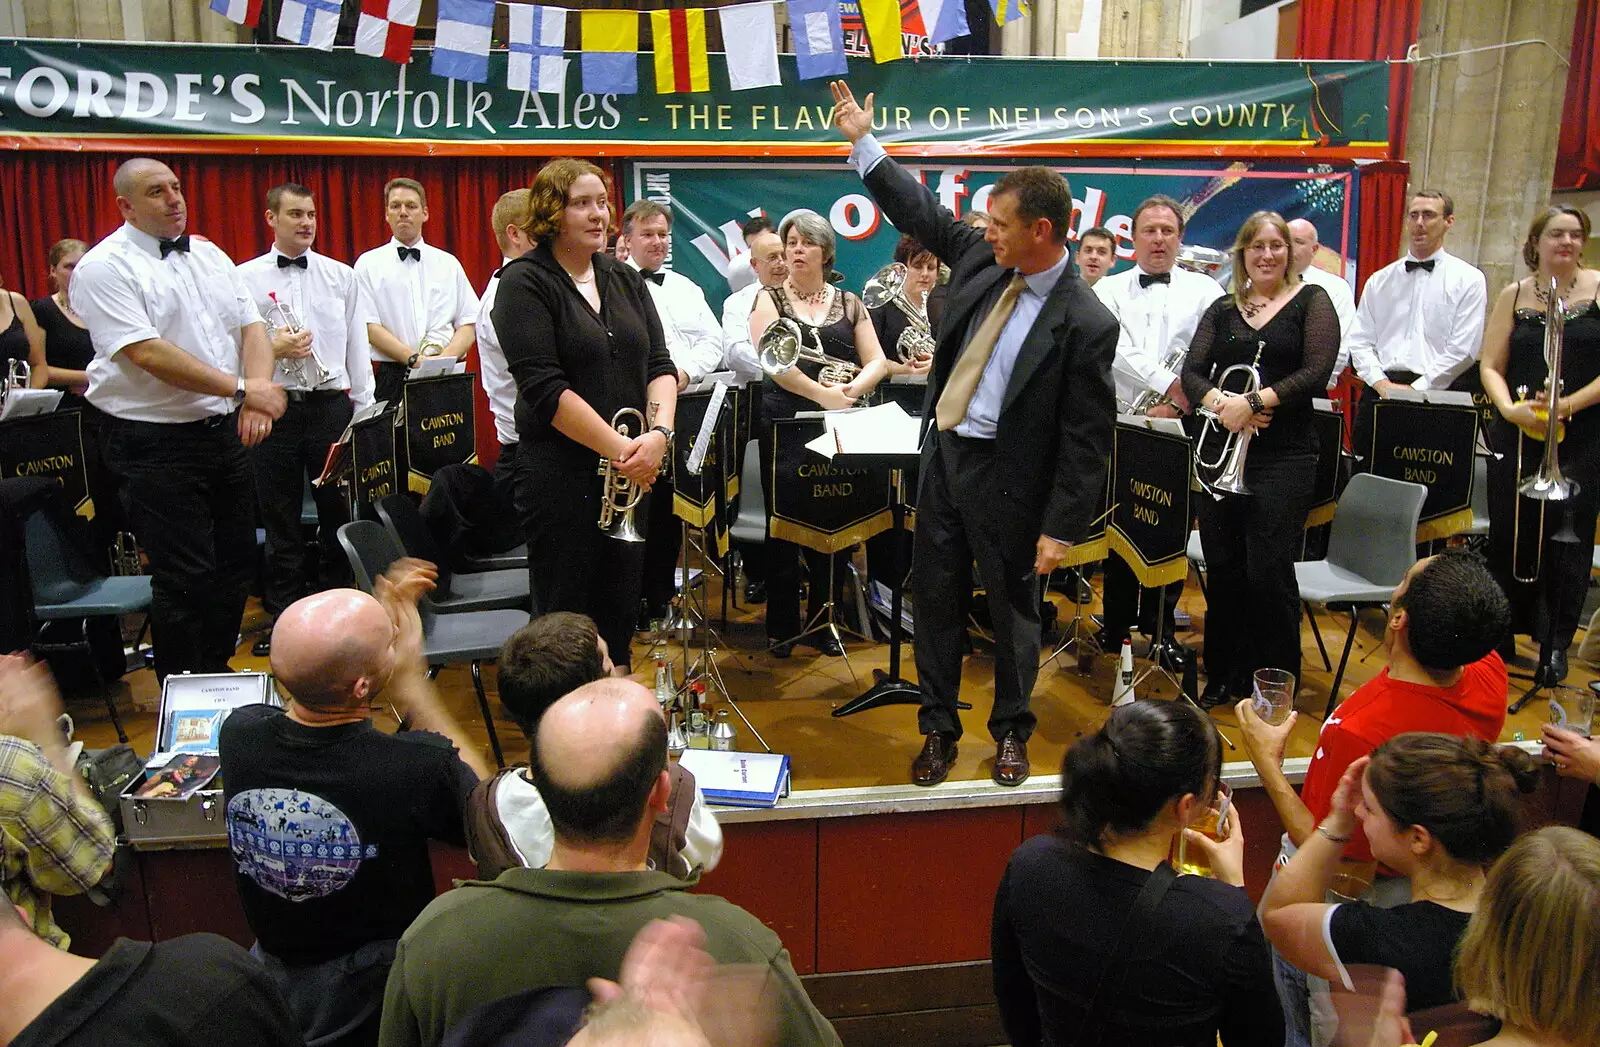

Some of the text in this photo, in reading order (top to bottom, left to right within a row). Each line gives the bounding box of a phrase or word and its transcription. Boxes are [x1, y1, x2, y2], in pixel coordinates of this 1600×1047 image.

[280, 64, 497, 135] Norfolk
[509, 59, 621, 130] Ales
[665, 104, 732, 130] THE
[752, 105, 911, 131] FLAVUR
[929, 106, 970, 131] OF
[989, 106, 1153, 131] NELSON'S
[1169, 103, 1295, 131] COUNTY
[421, 412, 464, 431] CAWSTON
[433, 432, 456, 449] BAND
[16, 454, 74, 477] CAWSTON
[1393, 446, 1454, 466] CAWSTON
[361, 460, 391, 483] CAWSTO
[1404, 467, 1437, 484] BAND
[813, 482, 853, 498] BAND
[1130, 478, 1172, 507] CAWSTON
[1134, 503, 1159, 527] BAND
